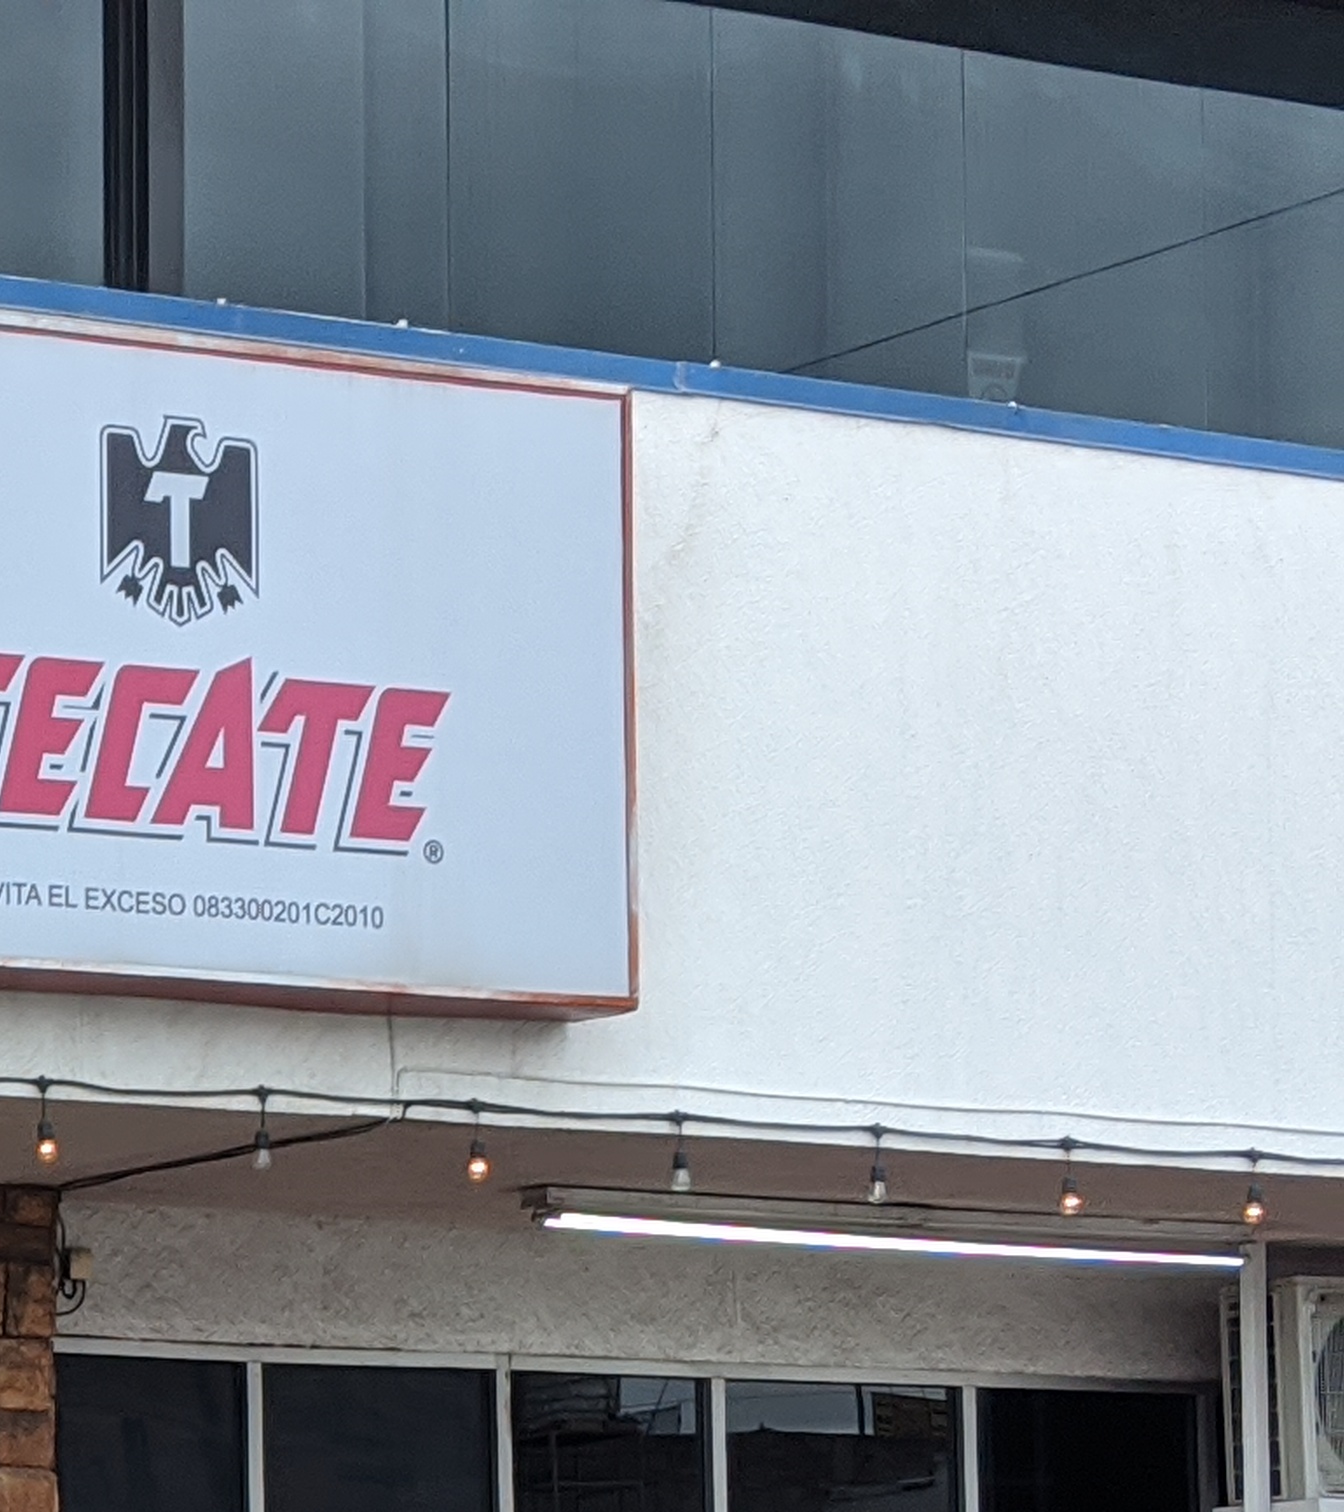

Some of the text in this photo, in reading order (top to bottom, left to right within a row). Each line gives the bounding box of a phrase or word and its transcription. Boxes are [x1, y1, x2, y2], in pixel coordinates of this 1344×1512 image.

[47, 884, 79, 909] EL
[84, 886, 187, 917] EXCESO
[192, 894, 385, 930] 083300201C2010
